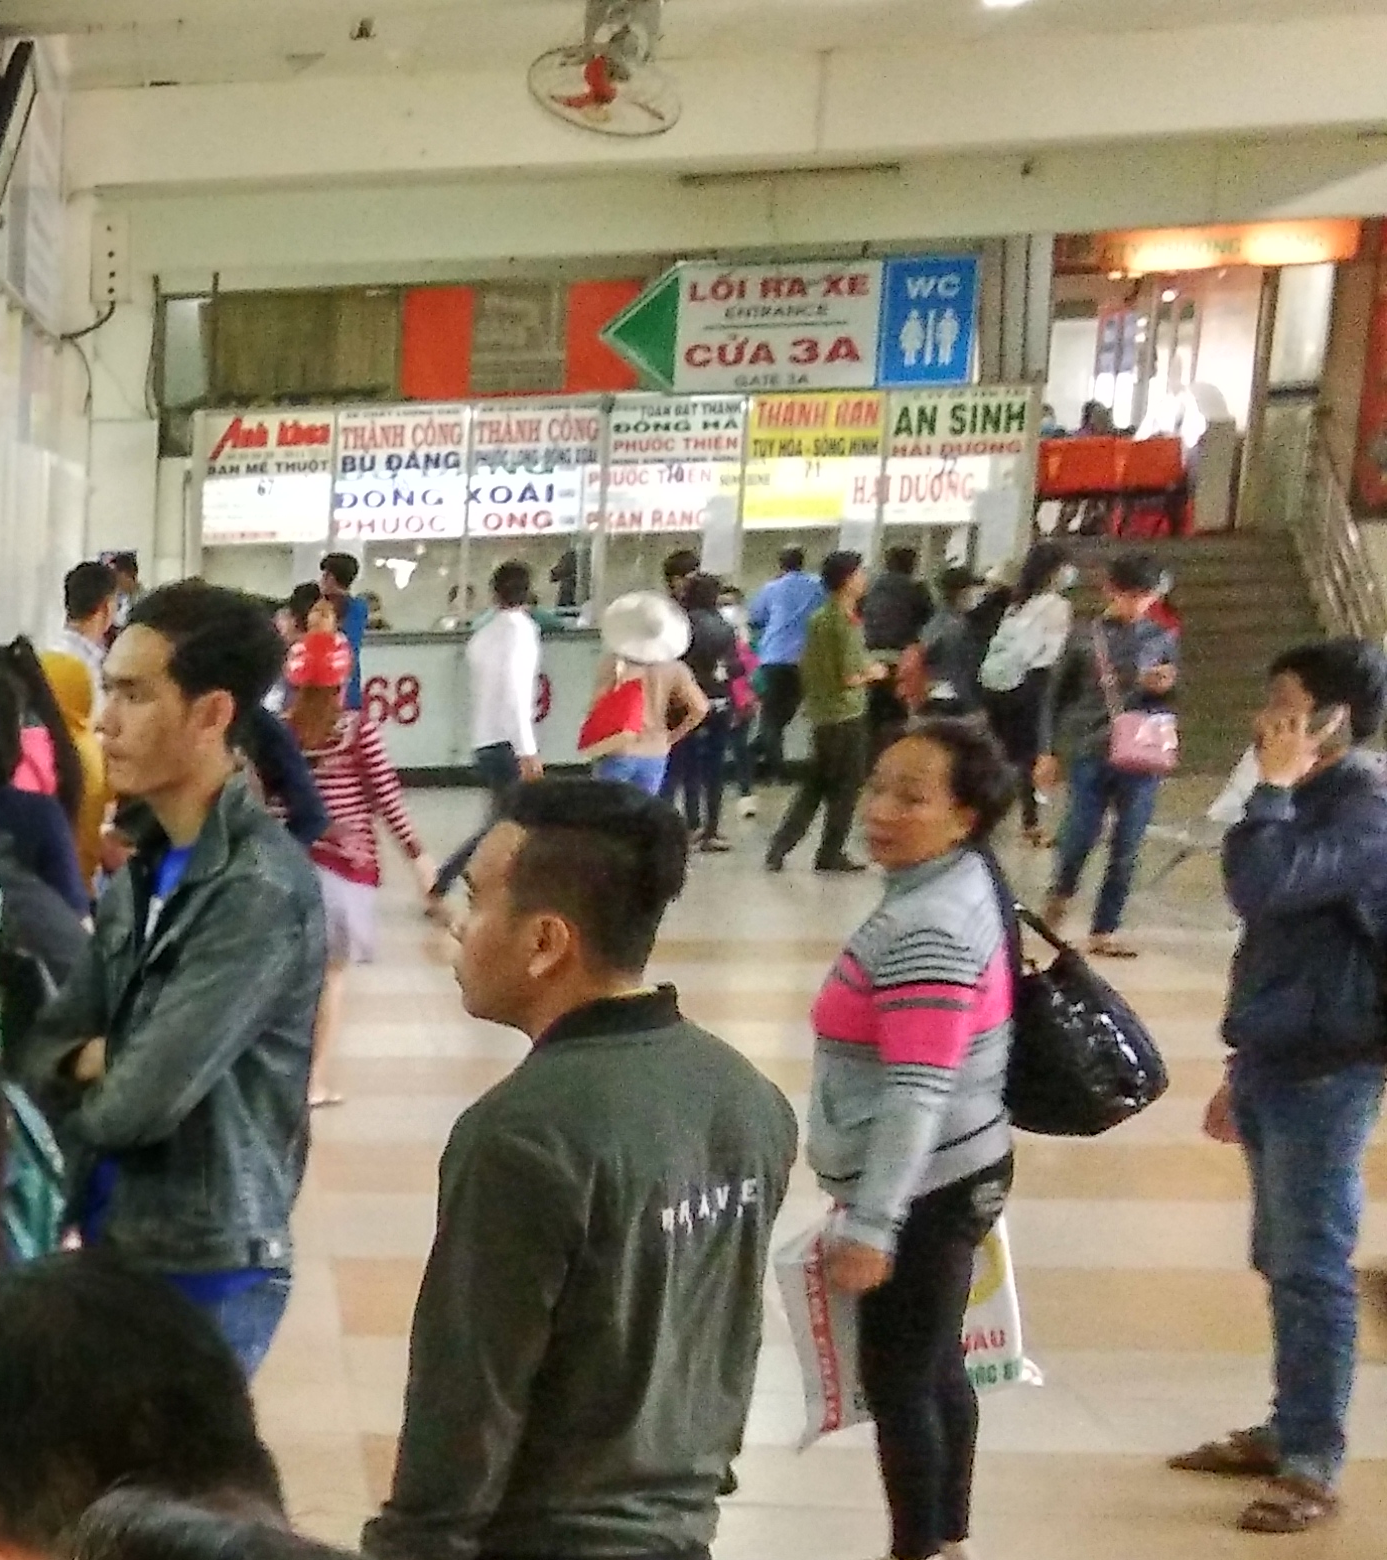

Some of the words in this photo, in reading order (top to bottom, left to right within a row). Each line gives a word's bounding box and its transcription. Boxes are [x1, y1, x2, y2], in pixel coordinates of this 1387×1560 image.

[759, 275, 807, 299] RA
[825, 272, 871, 298] XE
[904, 273, 962, 299] WC
[683, 334, 777, 369] CỬA
[787, 335, 862, 366] 3A
[734, 373, 782, 388] GATE
[893, 405, 938, 438] AN
[948, 401, 1027, 436] SINH
[363, 674, 421, 726] 68
